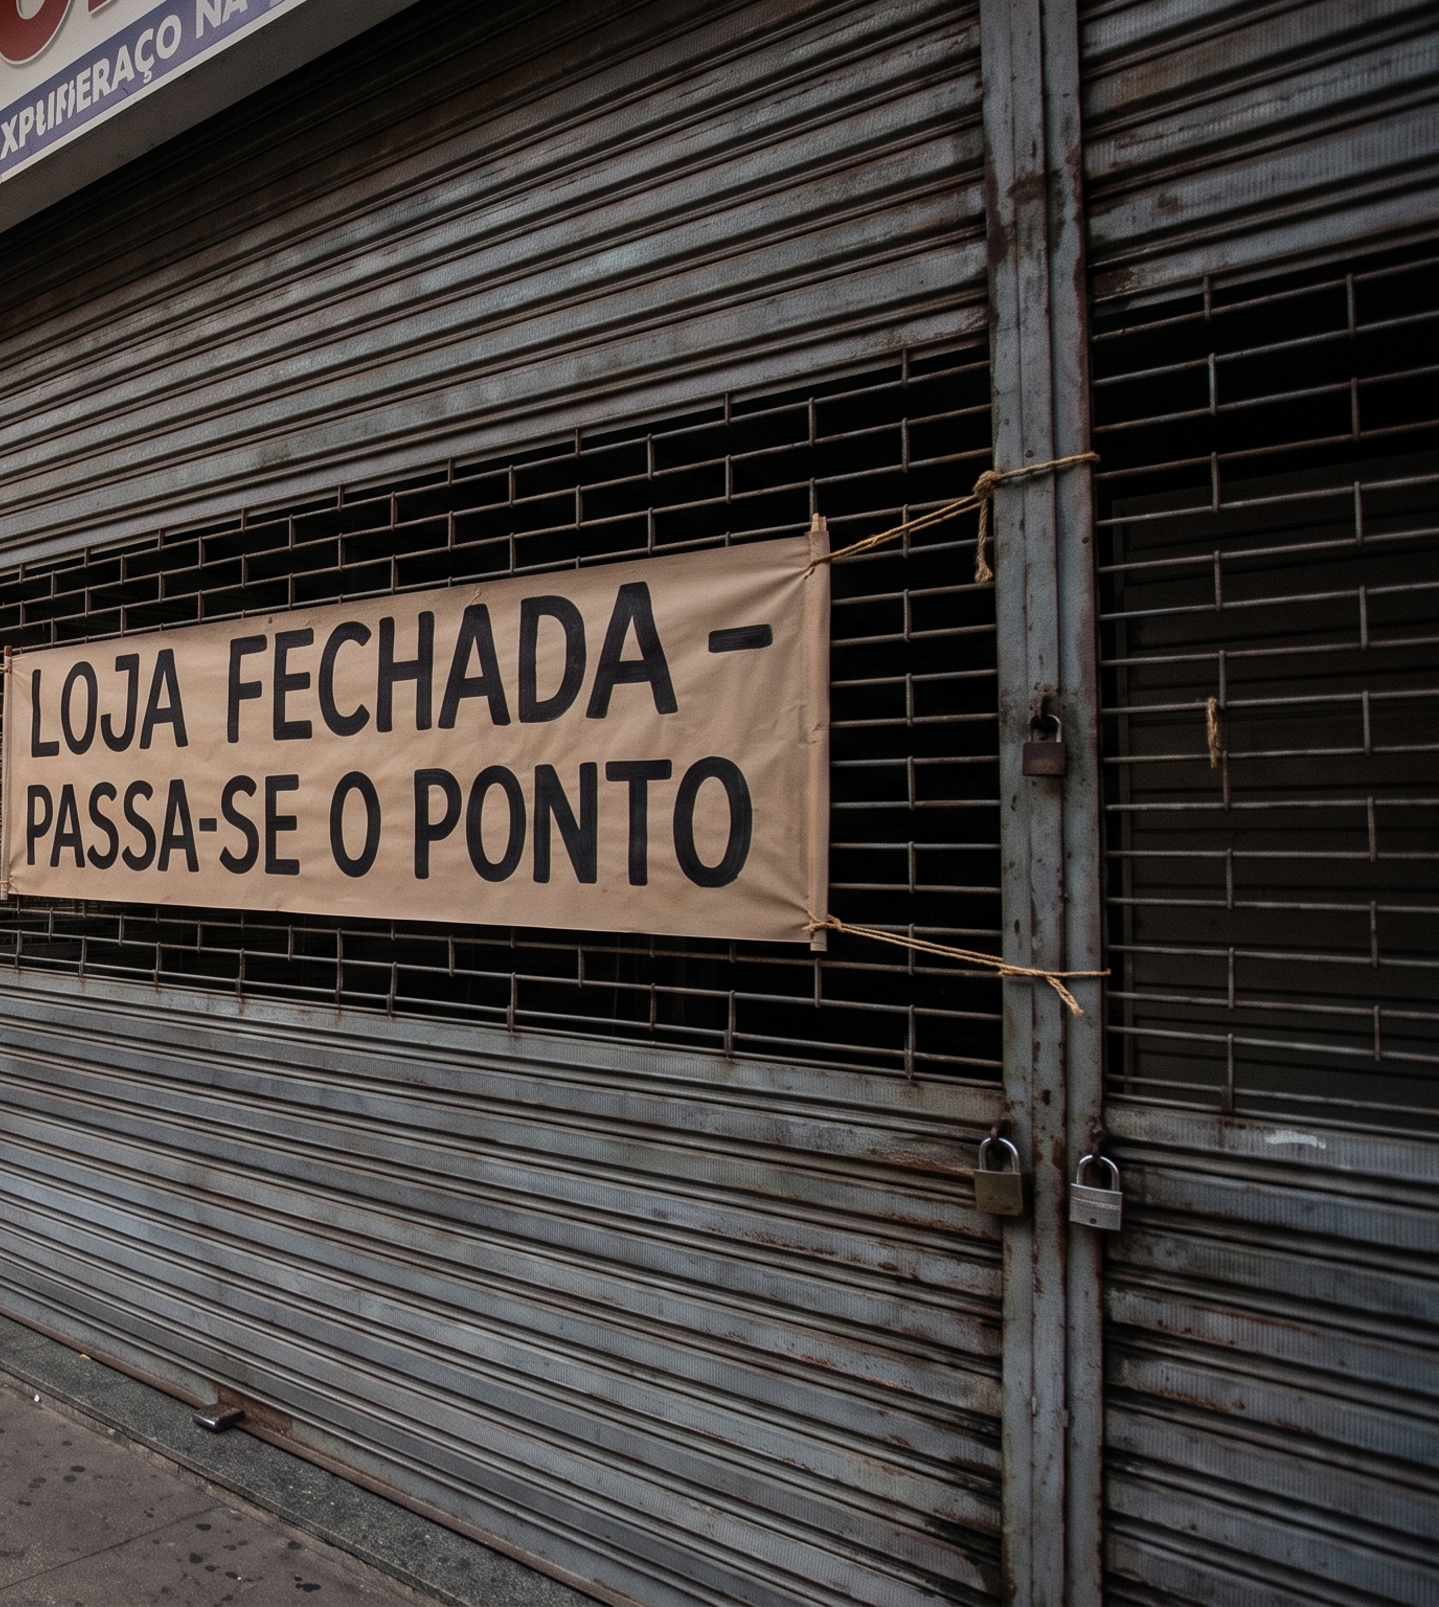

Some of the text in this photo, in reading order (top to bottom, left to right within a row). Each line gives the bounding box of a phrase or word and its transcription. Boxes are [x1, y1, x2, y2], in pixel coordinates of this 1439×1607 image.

[31, 648, 189, 758] LOJA
[227, 582, 679, 744] FECHADA
[26, 757, 753, 889] PASSA-SE O PONTO
